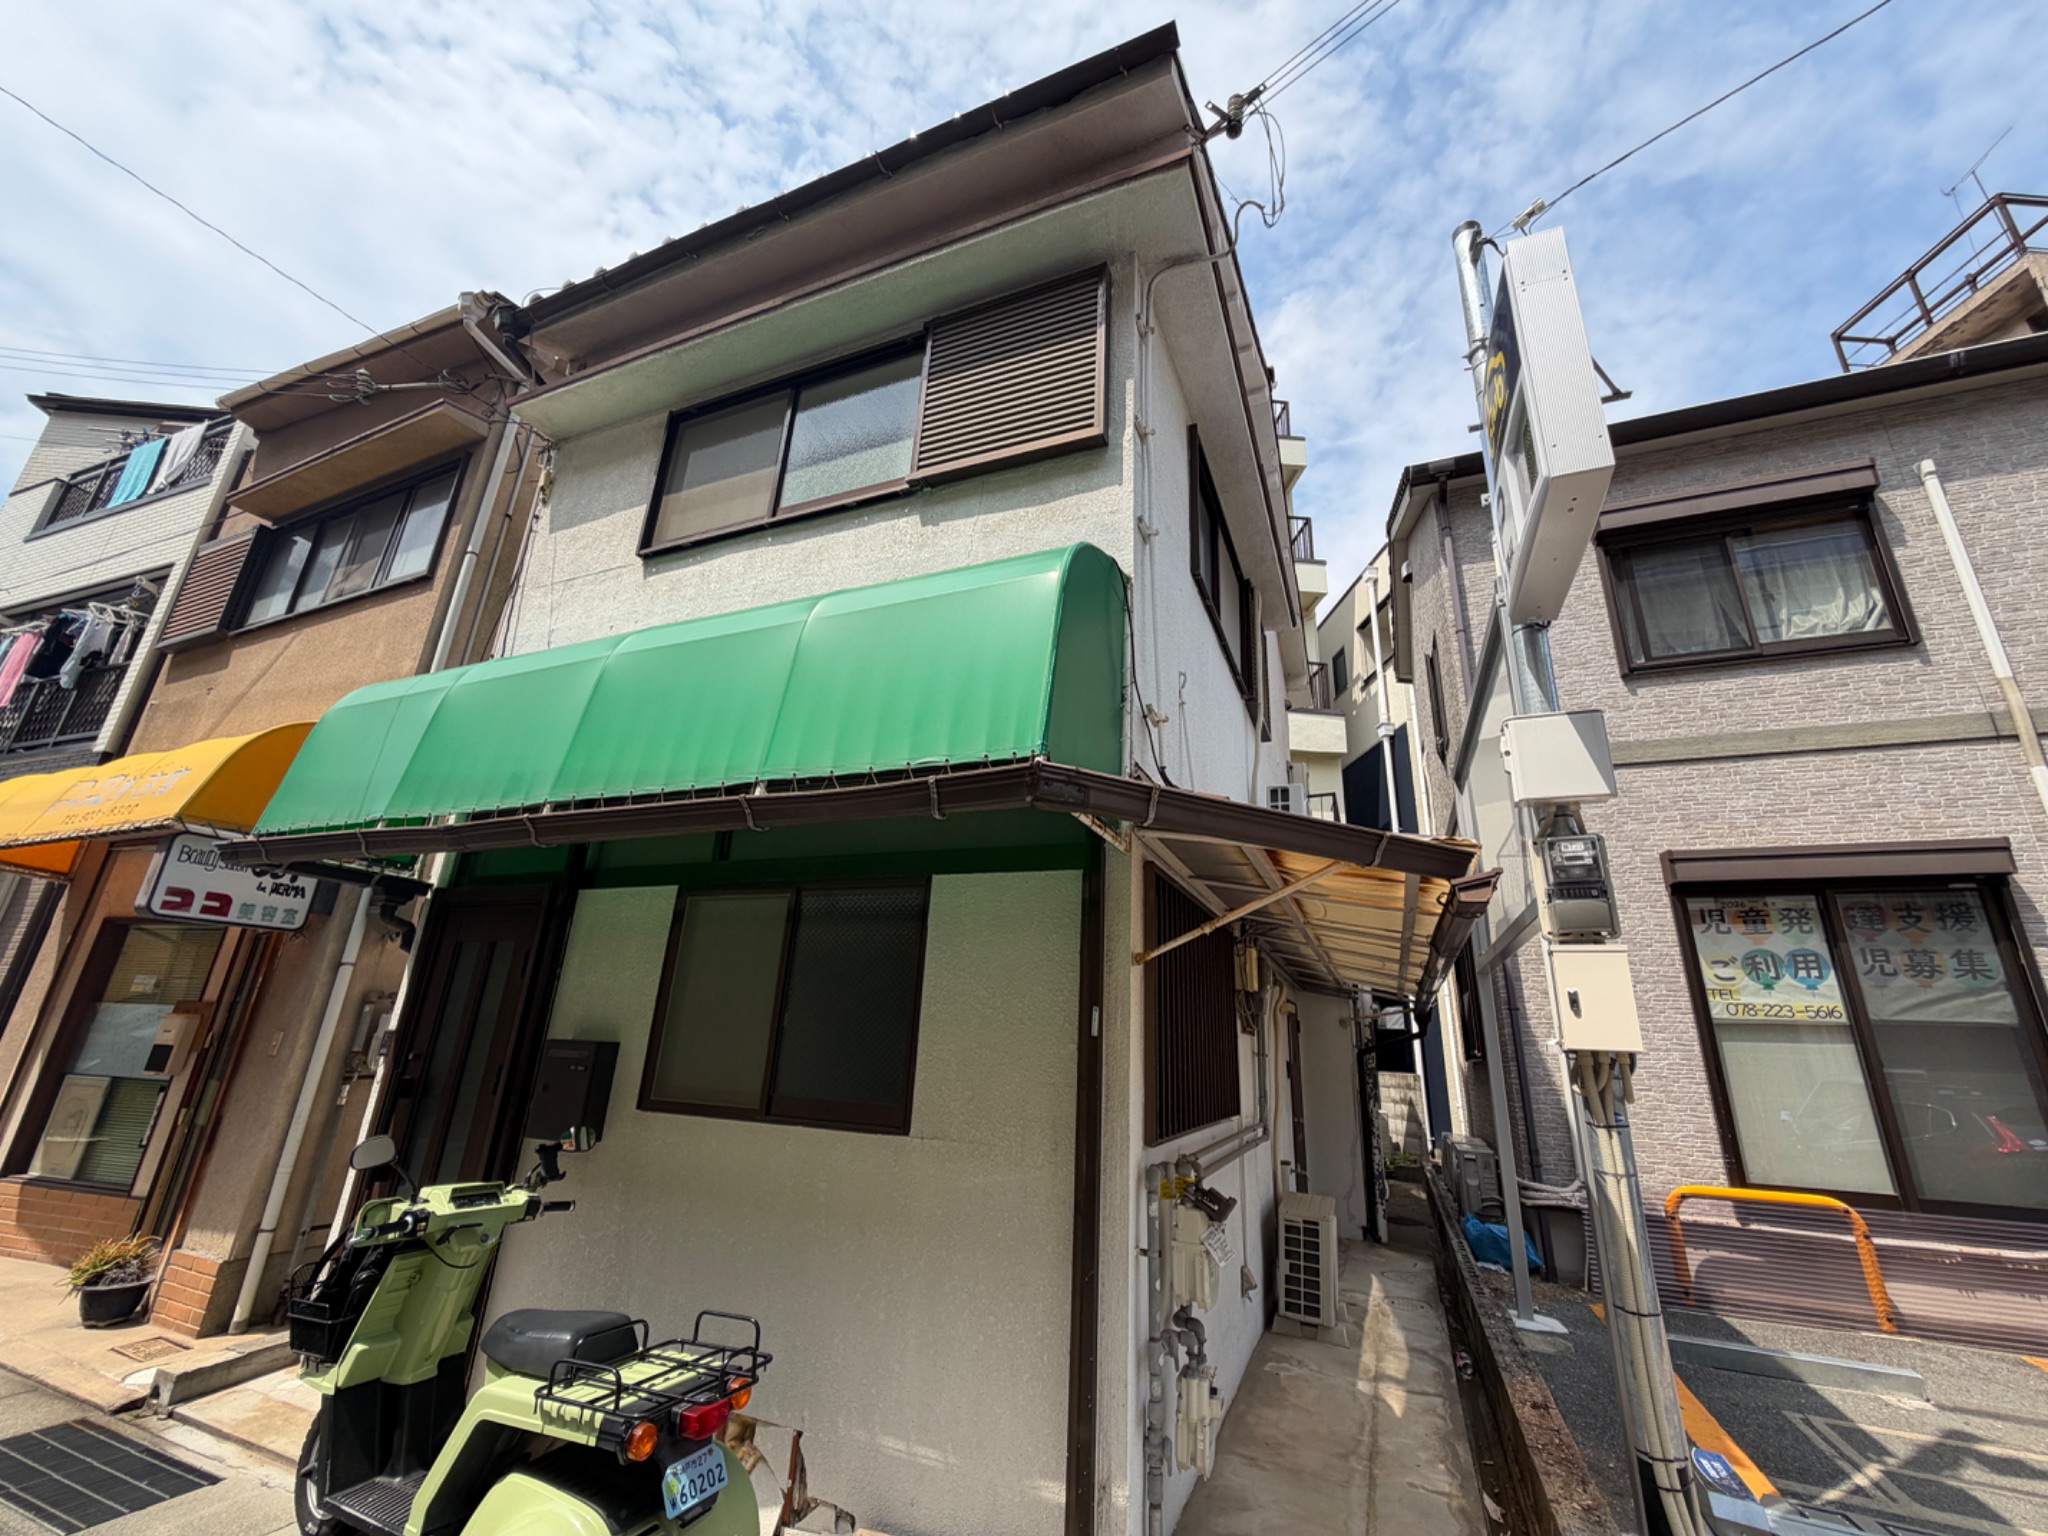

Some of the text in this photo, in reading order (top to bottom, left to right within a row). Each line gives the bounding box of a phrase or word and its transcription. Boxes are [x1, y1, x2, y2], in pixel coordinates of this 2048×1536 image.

[1709, 989, 1739, 1001] TEL
[1726, 1002, 1843, 1020] 078-223-5616
[680, 1463, 725, 1505] 60202
